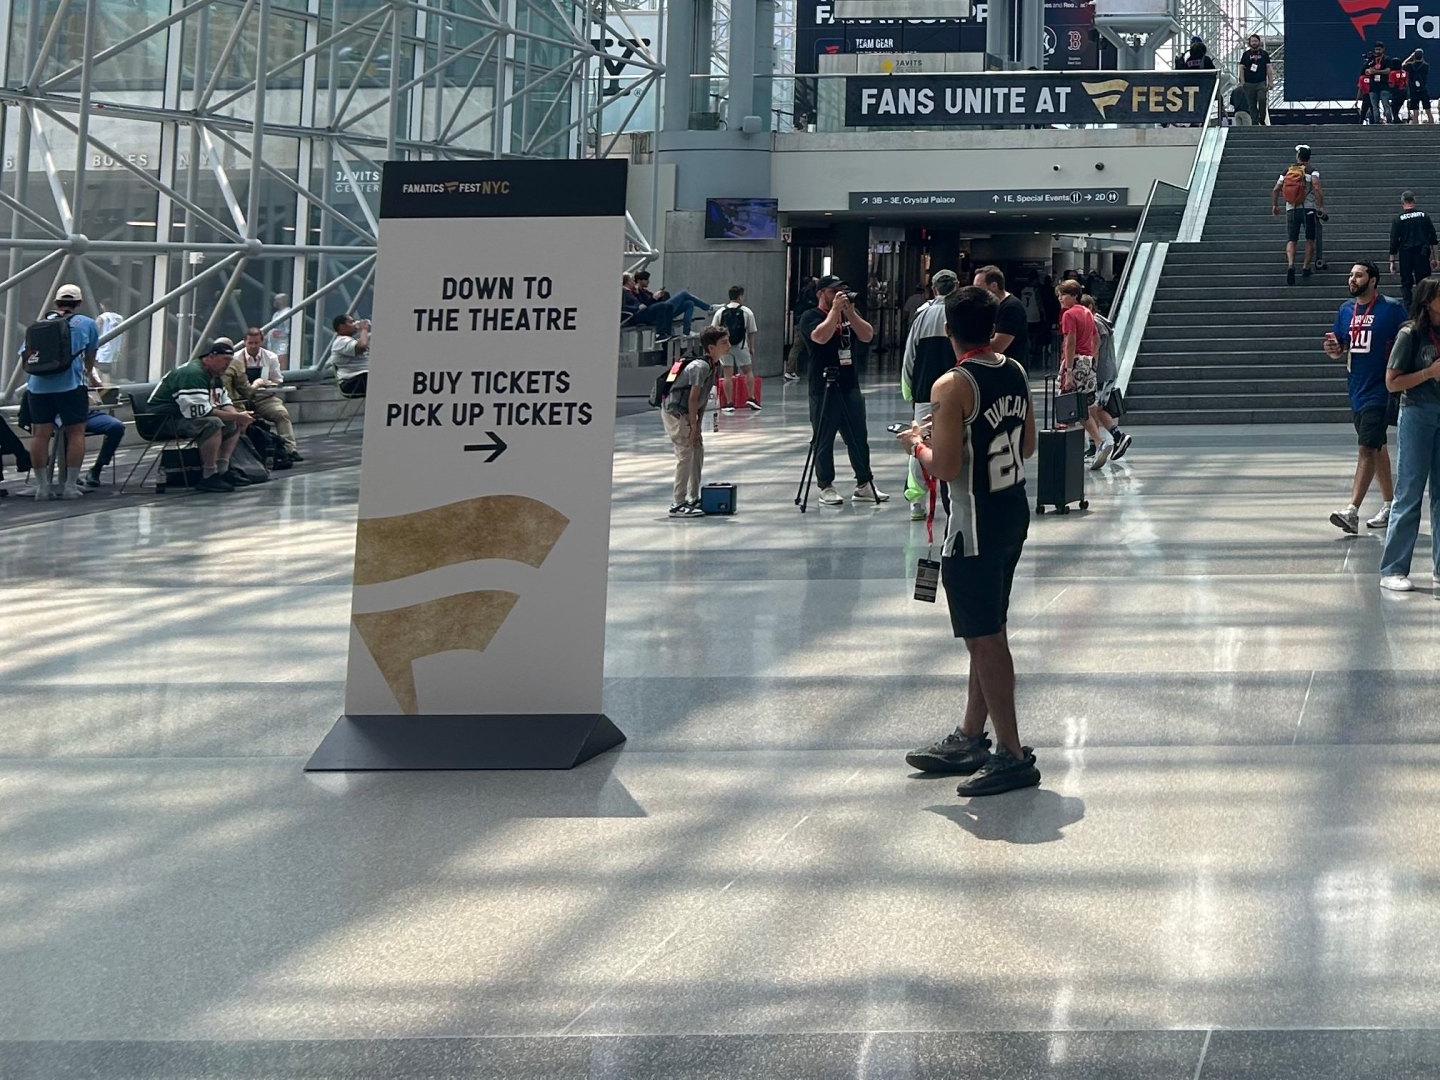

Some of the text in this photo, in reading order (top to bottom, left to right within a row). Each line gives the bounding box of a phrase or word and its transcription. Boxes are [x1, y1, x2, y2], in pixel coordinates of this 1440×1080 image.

[856, 38, 894, 49] TEAM GEAR
[860, 85, 1200, 116] FANS UNITE AT FEST
[92, 153, 148, 168] BUES
[336, 171, 380, 181] JAVITS
[403, 181, 510, 194] FANATICS FEST NYC
[889, 197, 901, 205] 3E,
[903, 196, 929, 205] Crystal
[1003, 194, 1070, 203] 1E, Special Events
[1095, 193, 1106, 201] 2D
[1400, 211, 1425, 221] SECURITY
[442, 276, 553, 300] DOWN TO
[413, 307, 577, 331] THE THEATRE
[412, 370, 570, 395] BUY TICKETS
[190, 404, 206, 418] 80
[386, 402, 593, 427] PICK UP TICKETS
[983, 395, 1028, 430] DUNCAN
